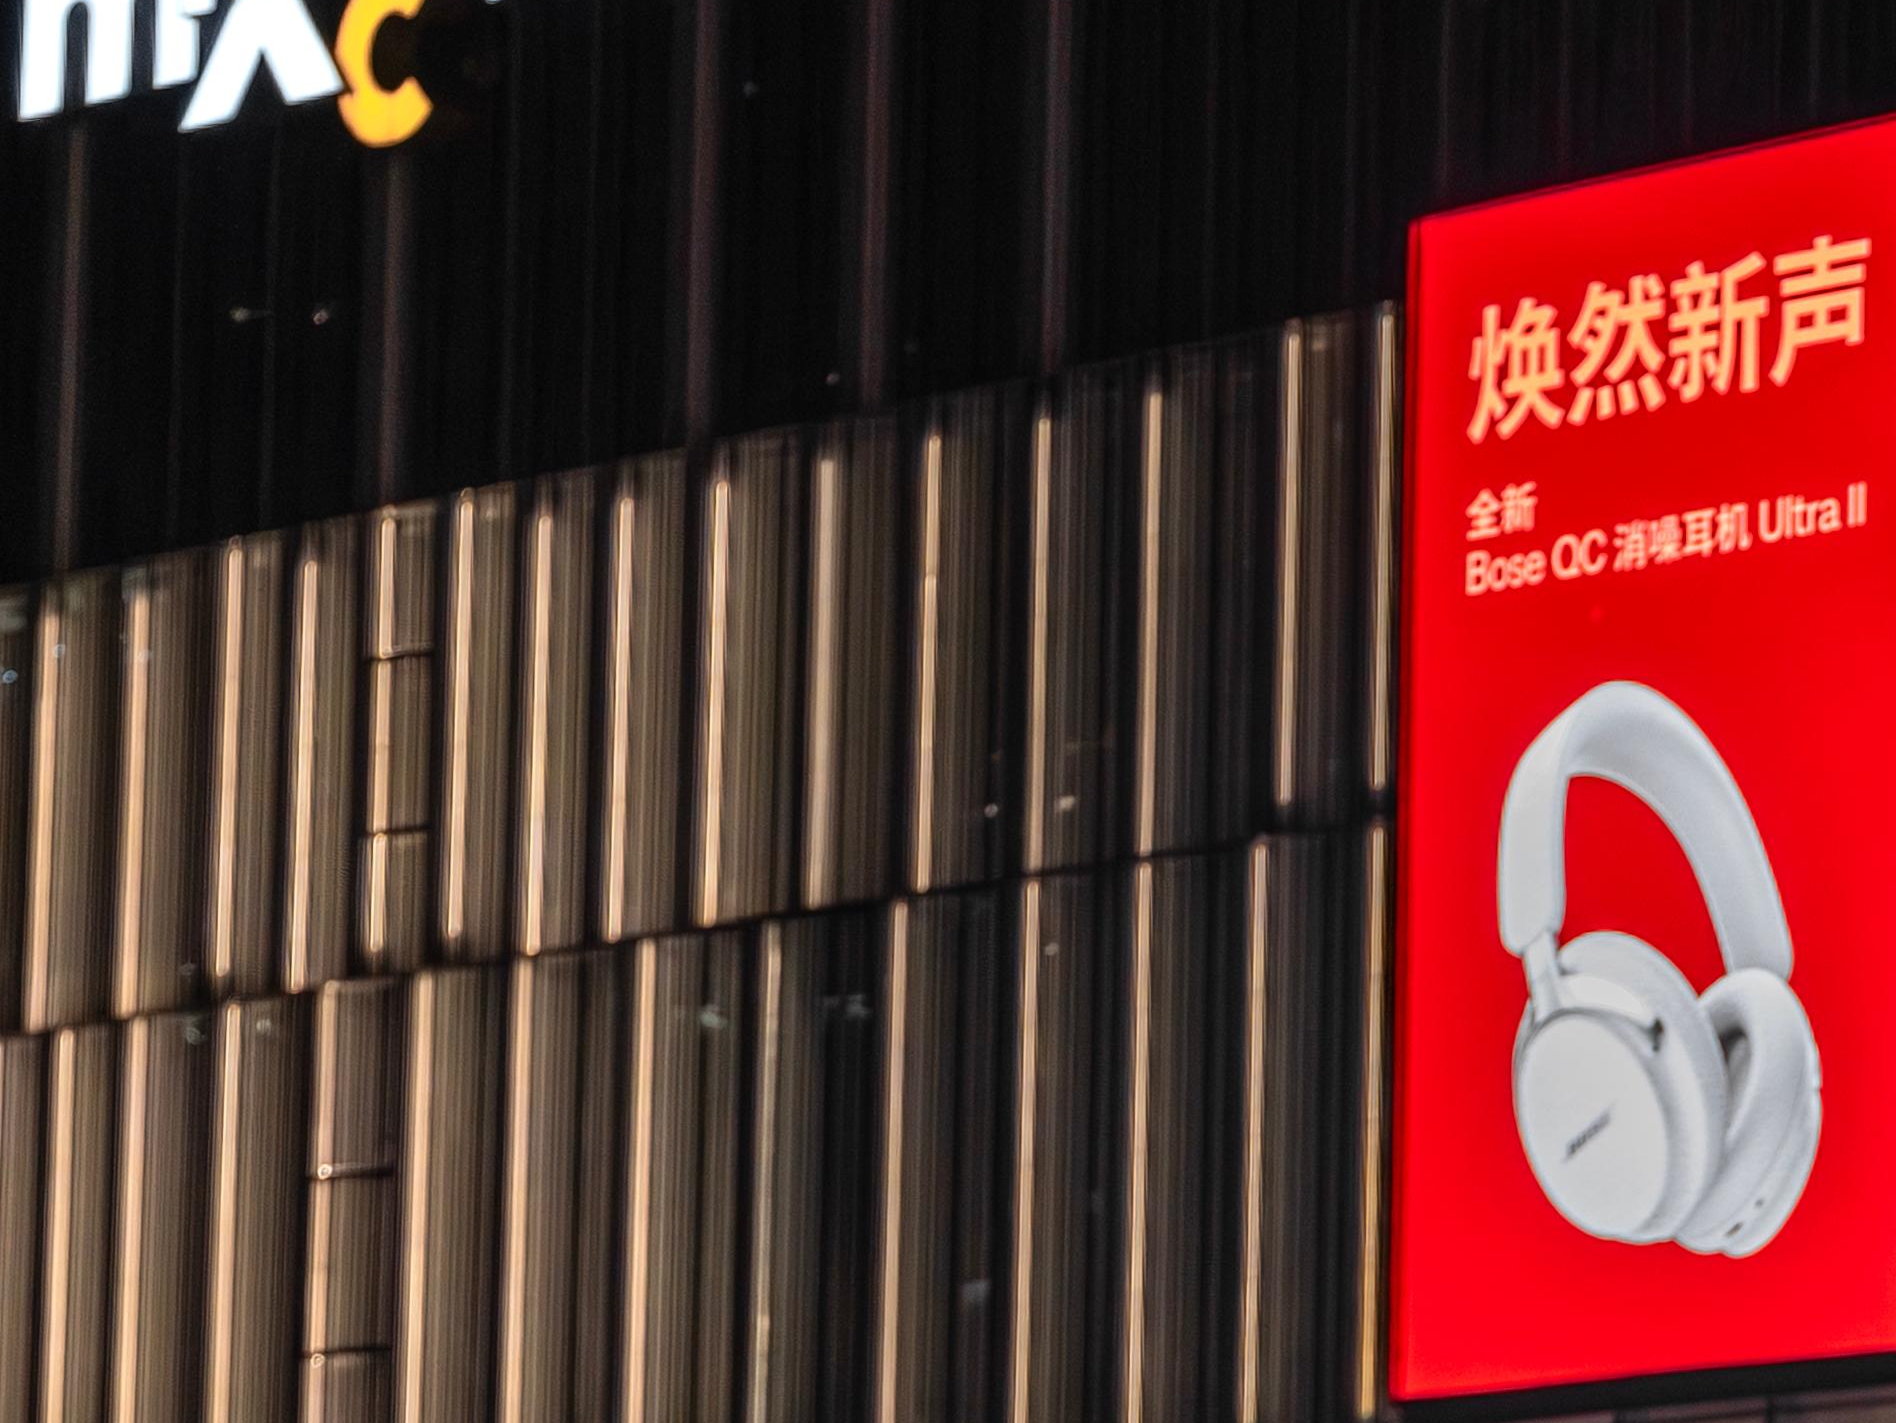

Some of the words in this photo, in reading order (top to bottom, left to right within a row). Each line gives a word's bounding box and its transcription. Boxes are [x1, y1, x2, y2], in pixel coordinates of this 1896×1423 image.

[1466, 234, 1872, 445] 焕然新声
[1465, 481, 1538, 541] 全新
[1465, 549, 1547, 596] Bose
[1551, 528, 1608, 580] QC
[1613, 502, 1753, 572] 消噪耳机
[1758, 494, 1842, 543] Ultra
